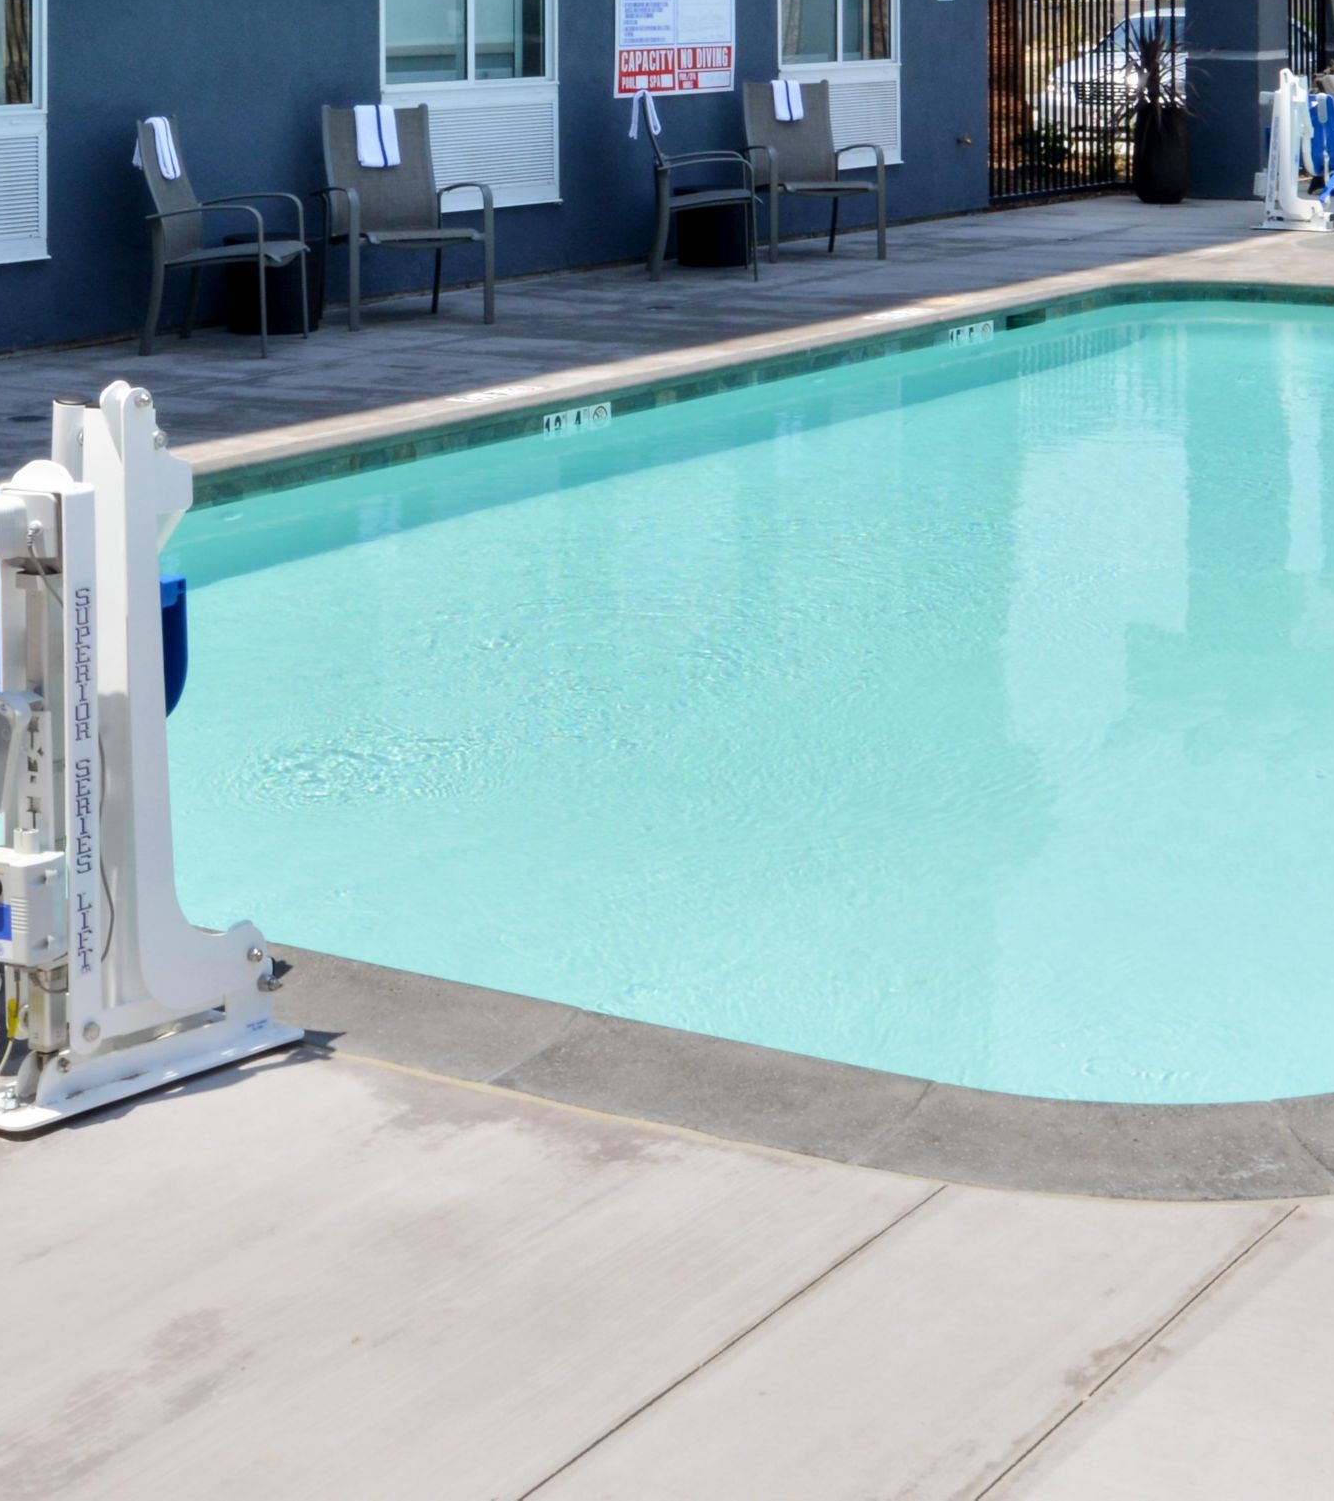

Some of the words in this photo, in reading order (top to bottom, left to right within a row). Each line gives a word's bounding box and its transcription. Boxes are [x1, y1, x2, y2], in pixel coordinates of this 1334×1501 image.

[621, 50, 674, 73] CAPACITY
[649, 74, 661, 88] SPA
[680, 48, 693, 69] NO
[696, 47, 729, 68] DIVING
[74, 587, 92, 742] SUPERIOR
[75, 758, 92, 874] SERIES
[76, 892, 94, 967] LIFT
